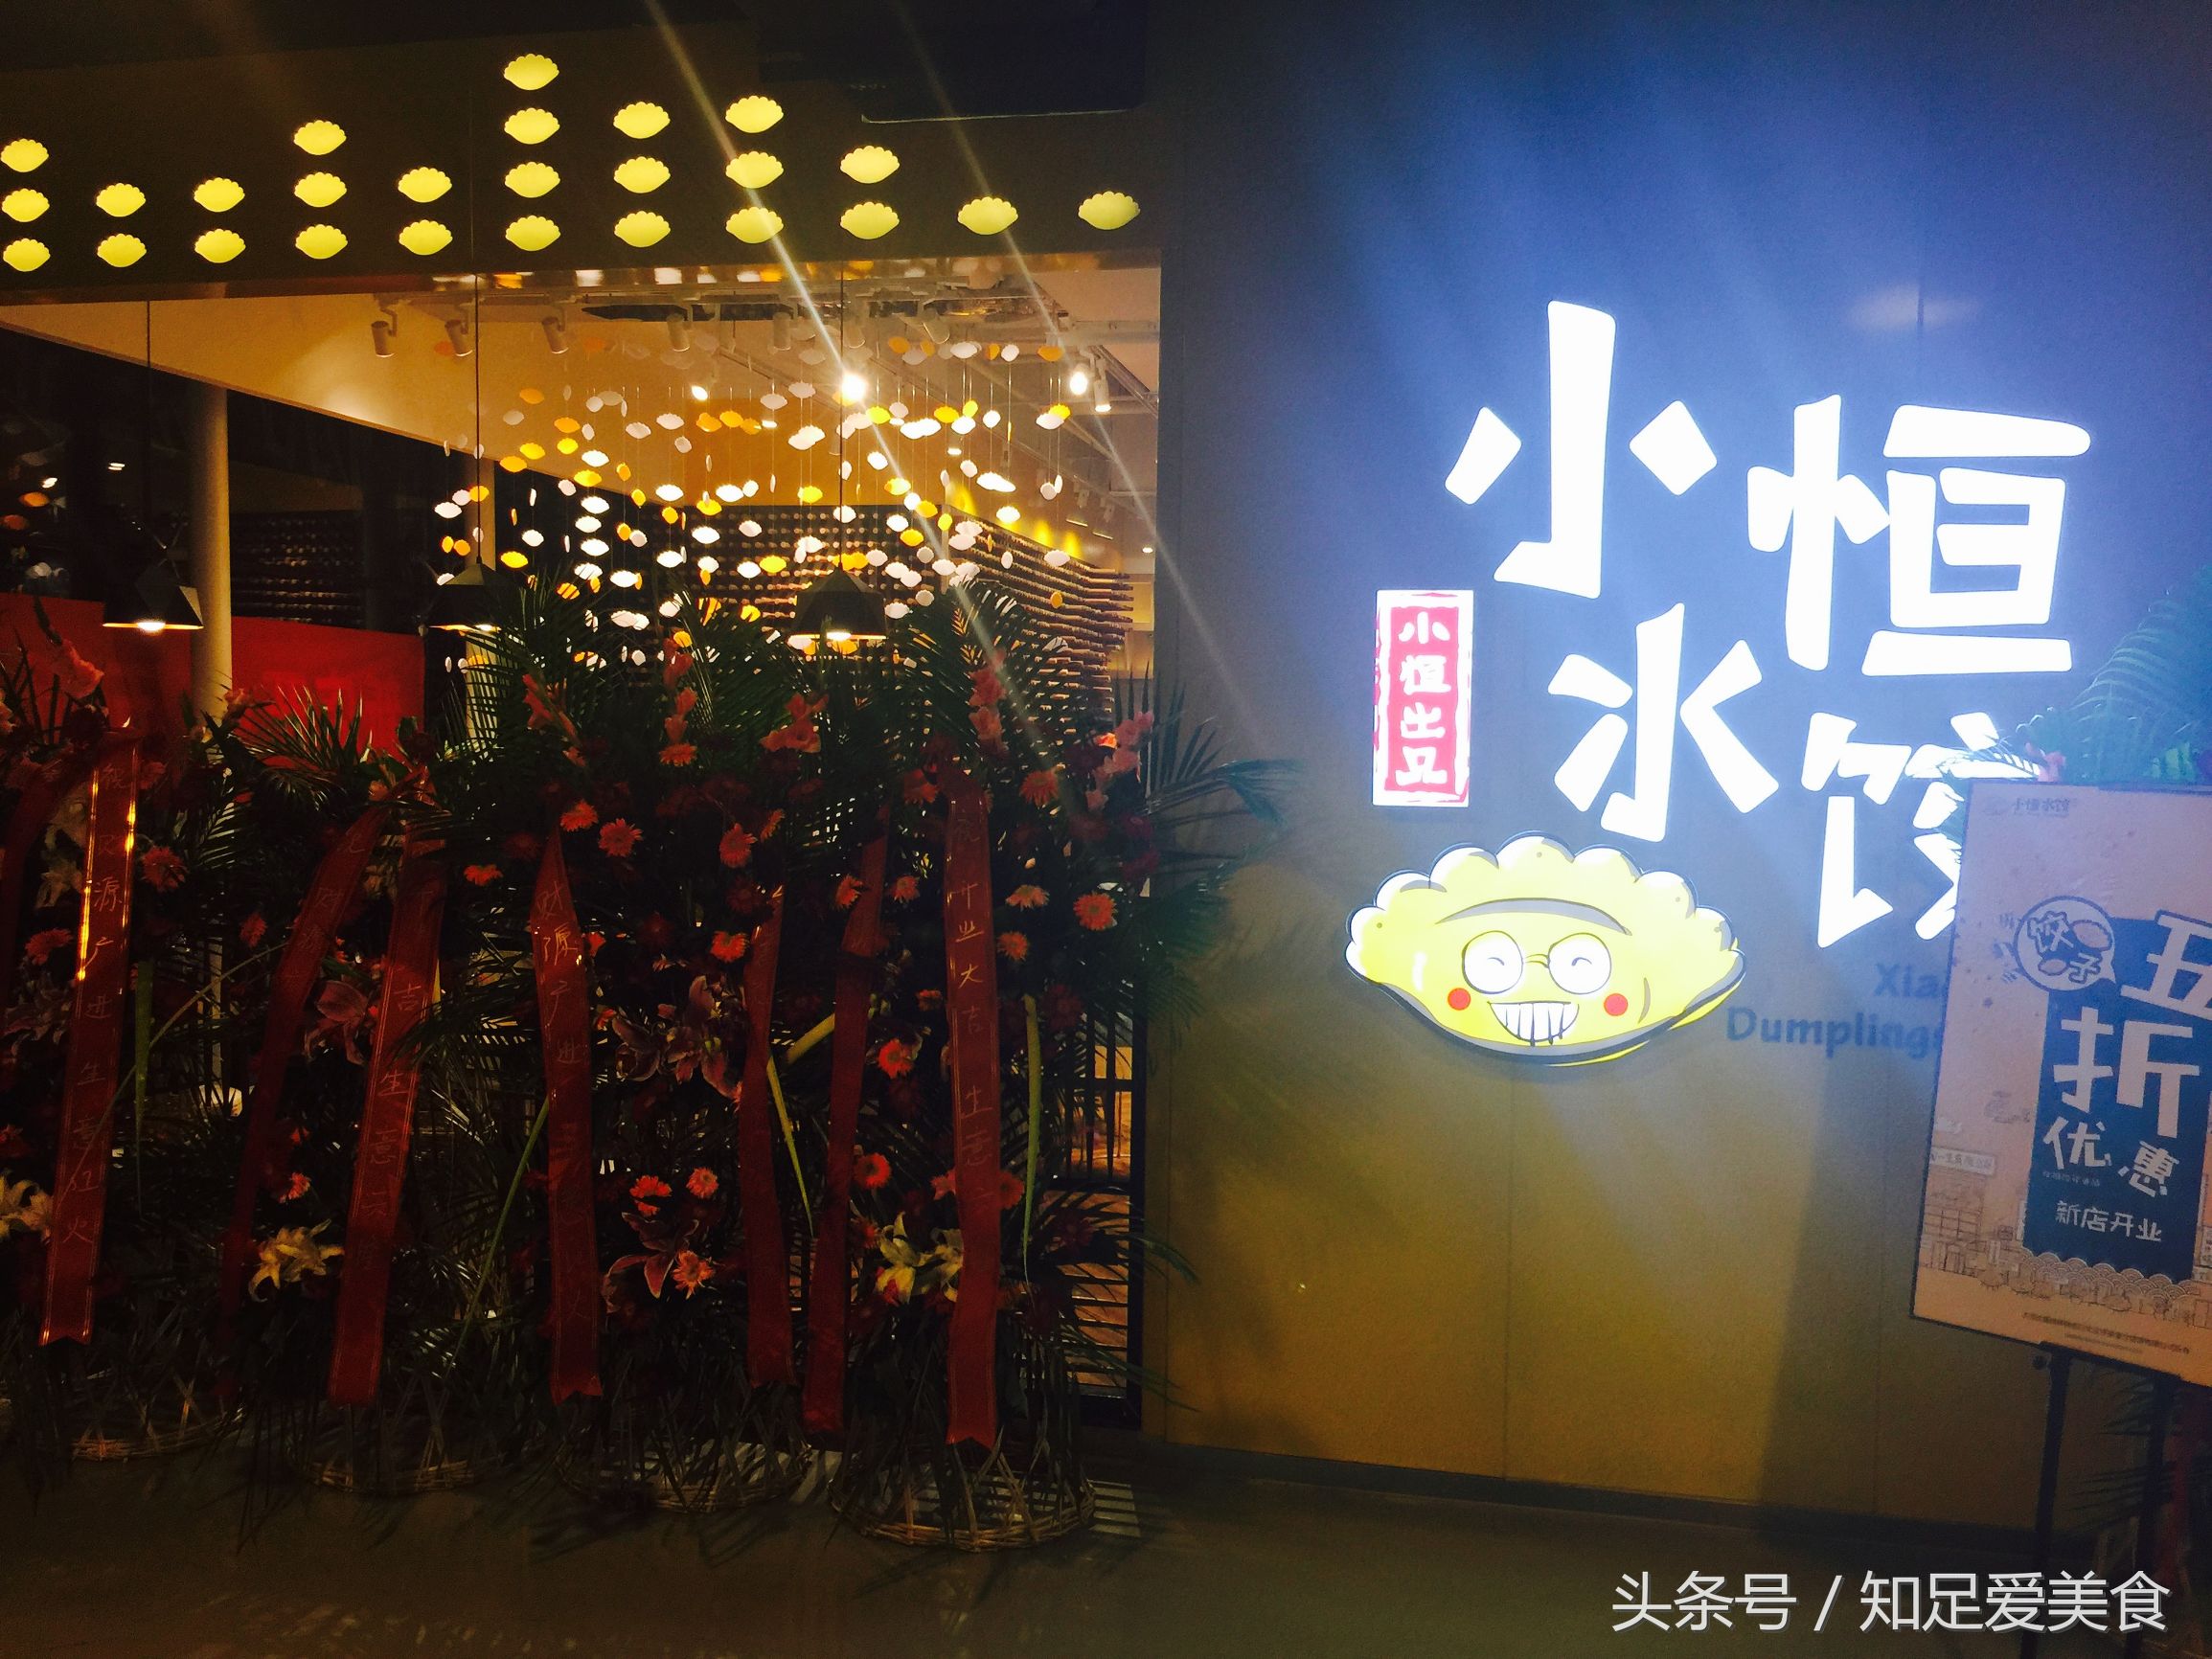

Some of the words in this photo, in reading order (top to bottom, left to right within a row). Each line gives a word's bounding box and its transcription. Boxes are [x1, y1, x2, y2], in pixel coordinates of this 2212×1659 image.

[1445, 300, 2090, 675] 小恒
[1873, 962, 1947, 998] Xia
[2055, 1199, 2163, 1242] 新店开业
